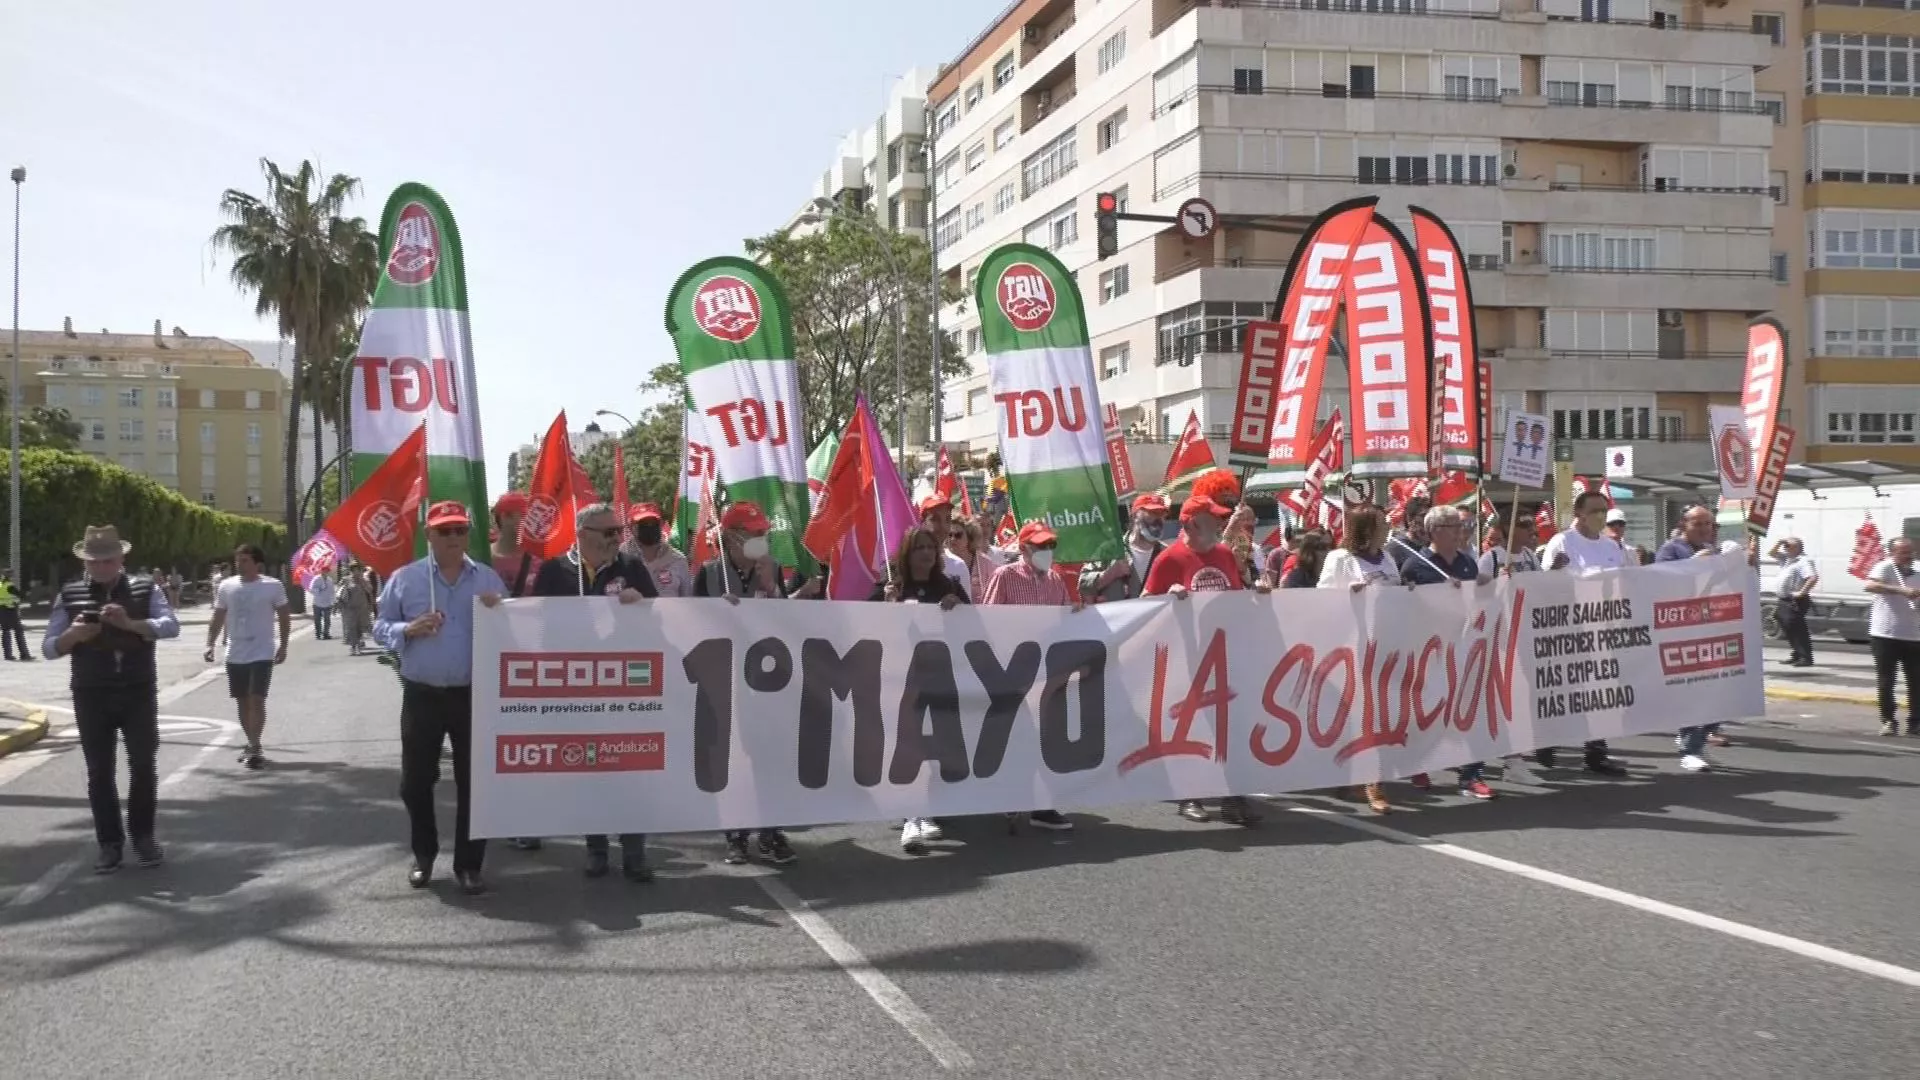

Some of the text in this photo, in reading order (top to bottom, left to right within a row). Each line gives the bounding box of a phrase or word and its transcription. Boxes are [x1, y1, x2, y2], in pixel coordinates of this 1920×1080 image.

[1271, 242, 1349, 440] CCOO
[1240, 329, 1280, 445] CCOO
[1270, 442, 1294, 458] ádiz
[1753, 428, 1790, 518] CCOO
[1532, 599, 1632, 629] SUBIR SALARIOS
[1657, 607, 1687, 624] UGT
[1534, 625, 1652, 659] CONTENER PRECIOS
[1663, 641, 1726, 667] CCOO
[507, 660, 623, 686] CCOO
[1536, 659, 1619, 689] MÁS EMPLEO
[798, 637, 1108, 789] MAYO
[1117, 627, 1237, 777] LA
[1249, 588, 1525, 767] SOLUCIÓN
[1538, 685, 1634, 719] MÁS IGUALDAD
[500, 700, 663, 715] unión provincial de Cádiz
[503, 743, 558, 766] UGT
